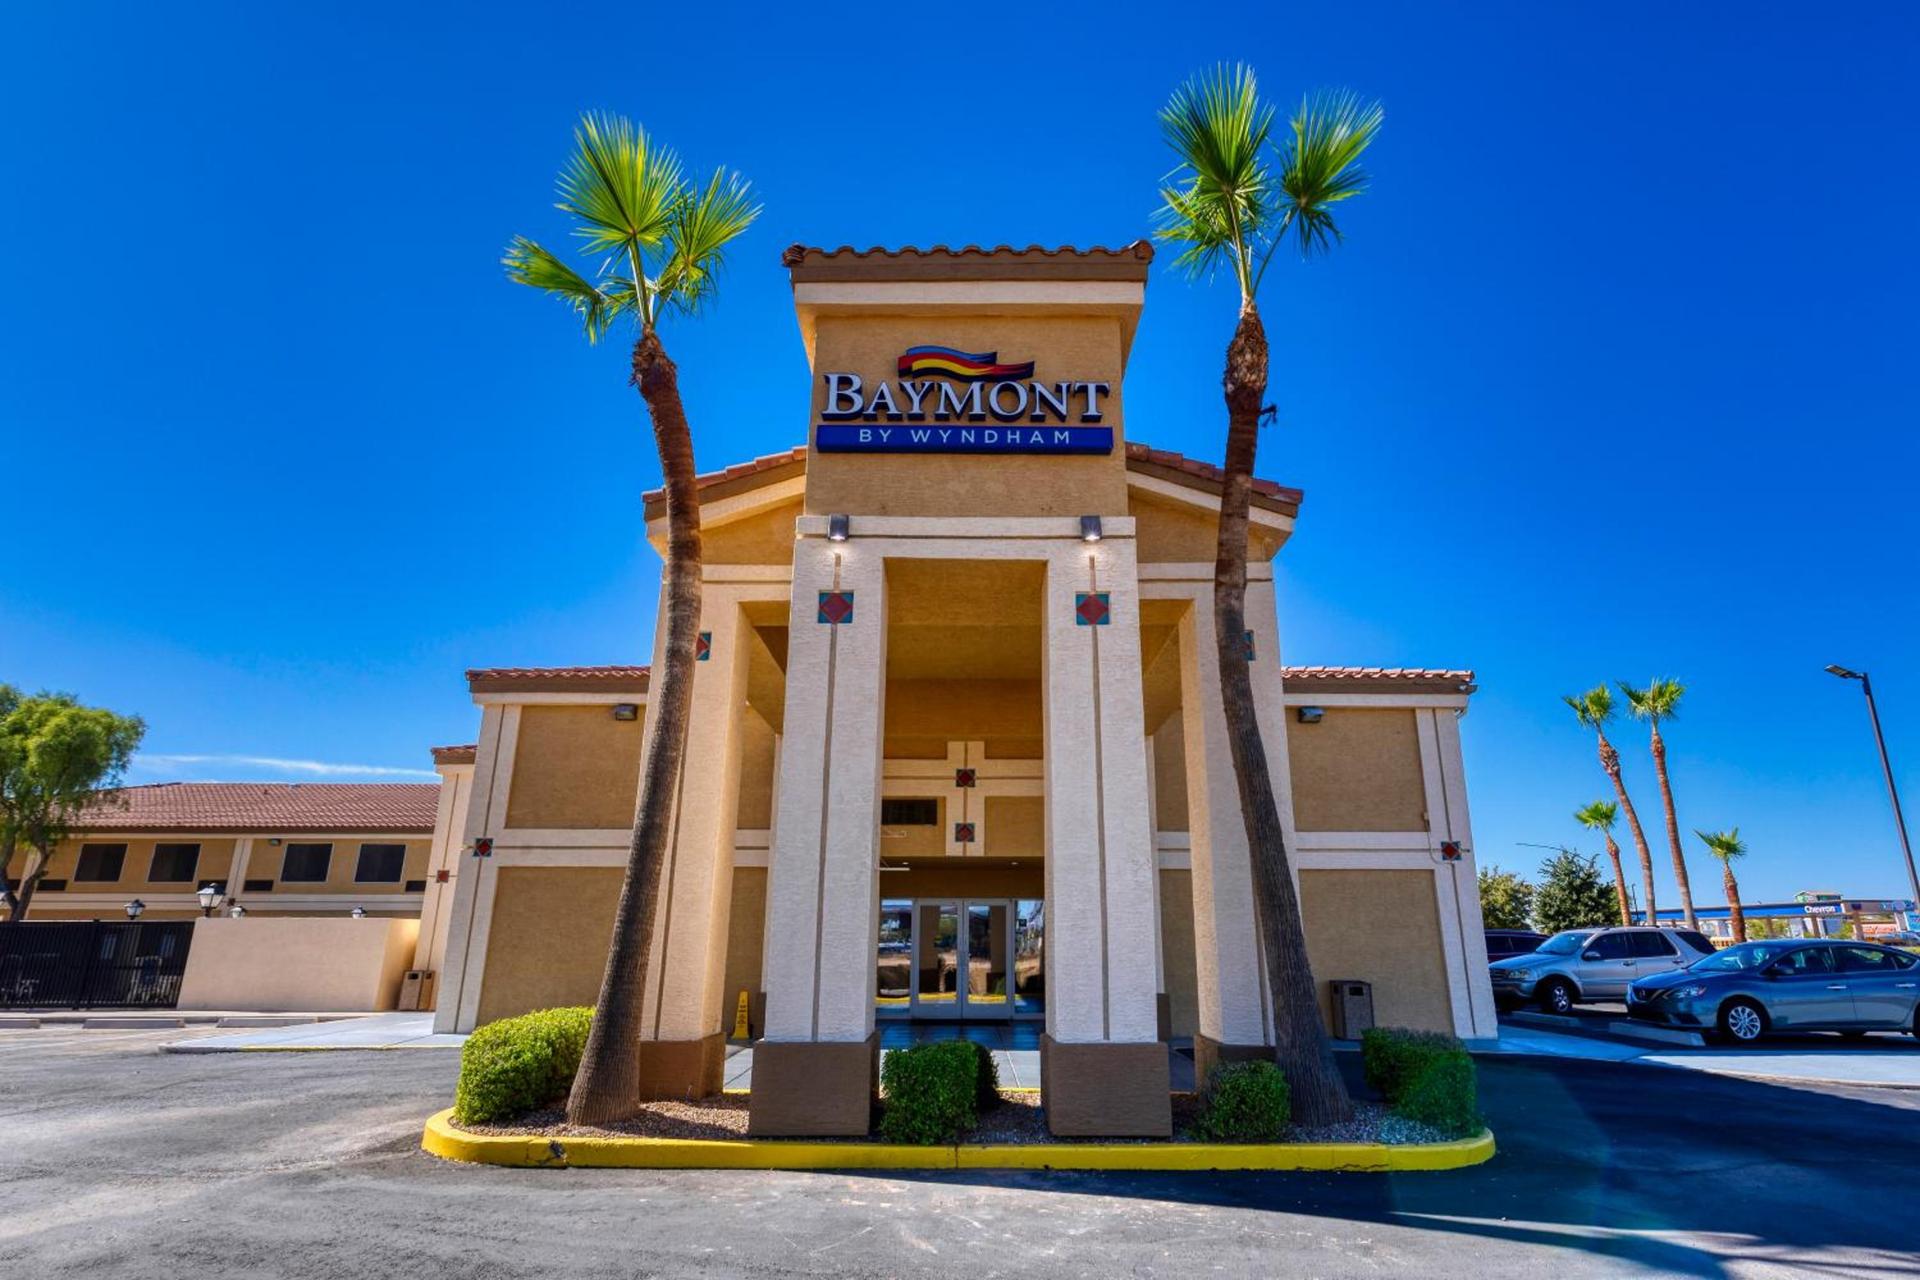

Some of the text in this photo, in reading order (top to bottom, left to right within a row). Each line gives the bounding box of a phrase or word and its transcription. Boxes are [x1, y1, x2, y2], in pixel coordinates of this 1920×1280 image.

[821, 372, 1110, 422] BAYMONT
[859, 429, 1071, 445] BY WYNDHAM
[1804, 905, 1836, 914] Chevron
